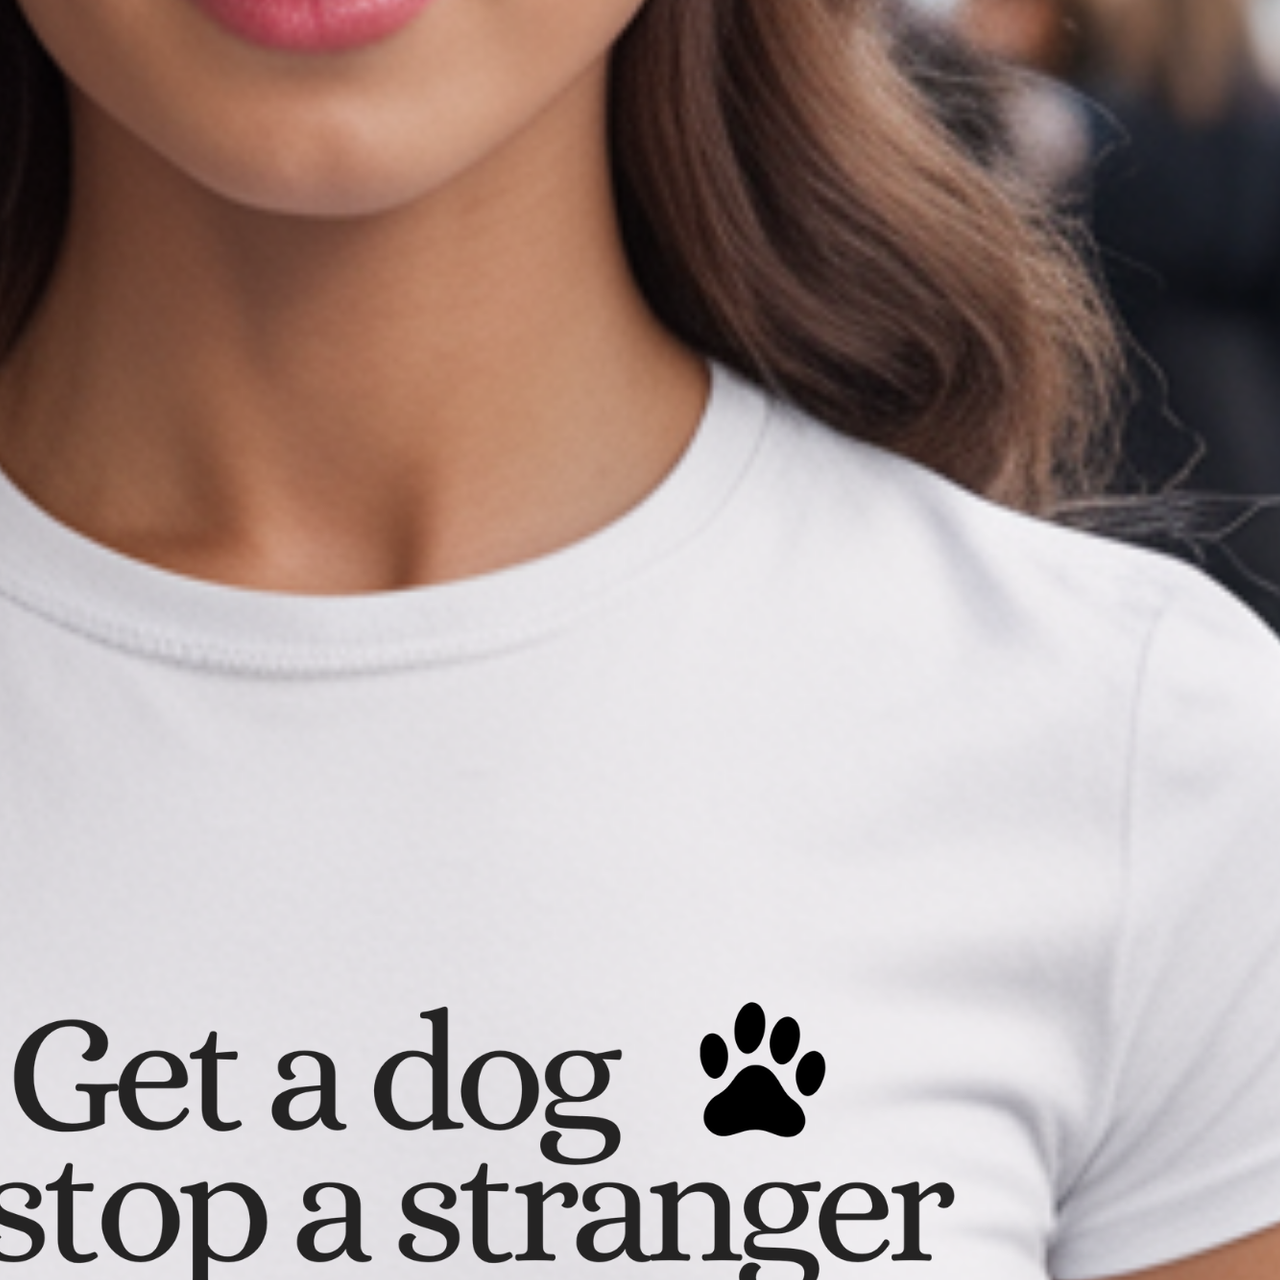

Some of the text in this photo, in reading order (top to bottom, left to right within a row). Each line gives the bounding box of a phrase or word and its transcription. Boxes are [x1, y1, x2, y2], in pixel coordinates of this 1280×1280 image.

[12, 1006, 623, 1166] Get a dog
[296, 1182, 373, 1264] a
